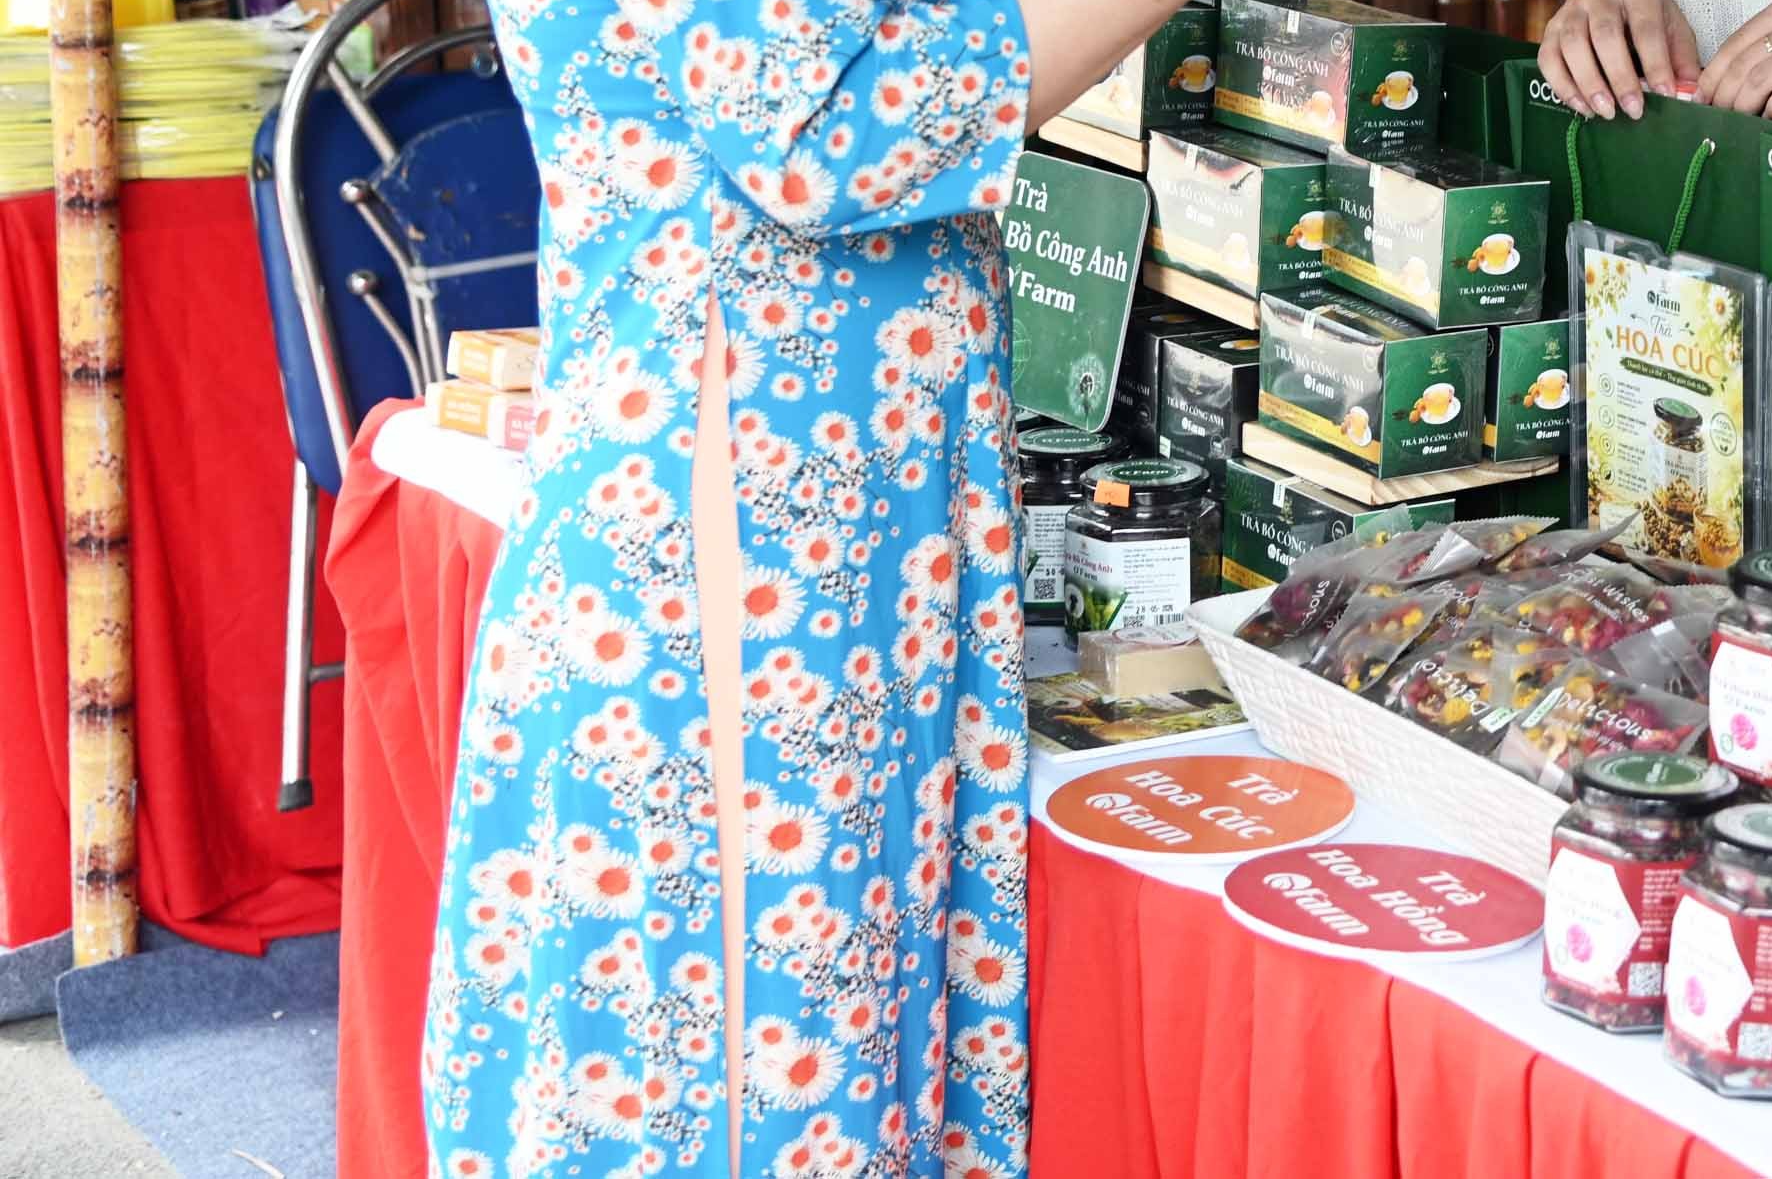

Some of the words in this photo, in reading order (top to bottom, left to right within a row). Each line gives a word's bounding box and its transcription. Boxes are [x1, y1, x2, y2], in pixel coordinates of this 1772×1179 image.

[1235, 40, 1255, 57] TRÀ
[1016, 178, 1048, 212] Trà
[1005, 220, 1032, 252] Bồ
[1036, 230, 1087, 276] Công
[1087, 245, 1128, 282] Anh
[1616, 324, 1665, 362] HOA
[1672, 342, 1722, 379] CÚC
[1240, 511, 1259, 533] TRÀ
[1555, 692, 1653, 742] Delicious
[1124, 770, 1204, 806] Hoa
[1199, 806, 1275, 840] Cúc
[1226, 772, 1299, 806] Trà
[1306, 849, 1380, 889] Hoa
[1369, 890, 1470, 946] Hồng
[1417, 871, 1487, 906] Trà
